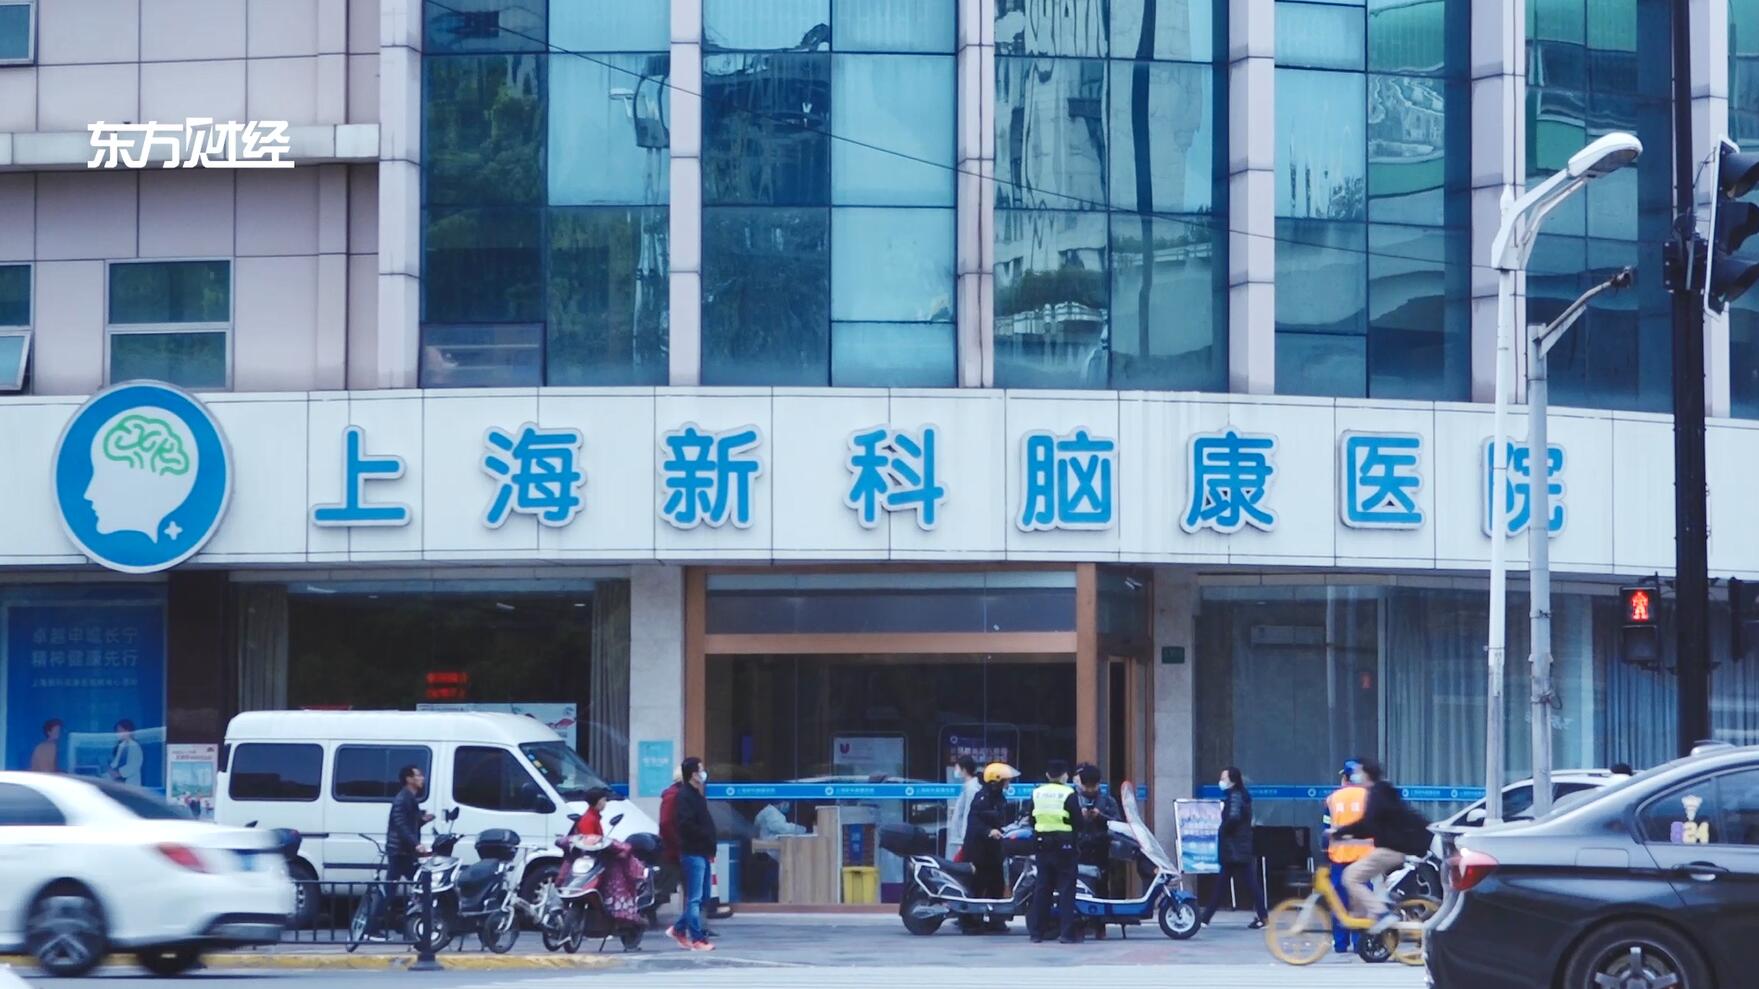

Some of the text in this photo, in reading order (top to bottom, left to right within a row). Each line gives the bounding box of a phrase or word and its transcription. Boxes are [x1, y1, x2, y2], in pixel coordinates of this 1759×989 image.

[315, 428, 1563, 534] 上海新科脑康医院
